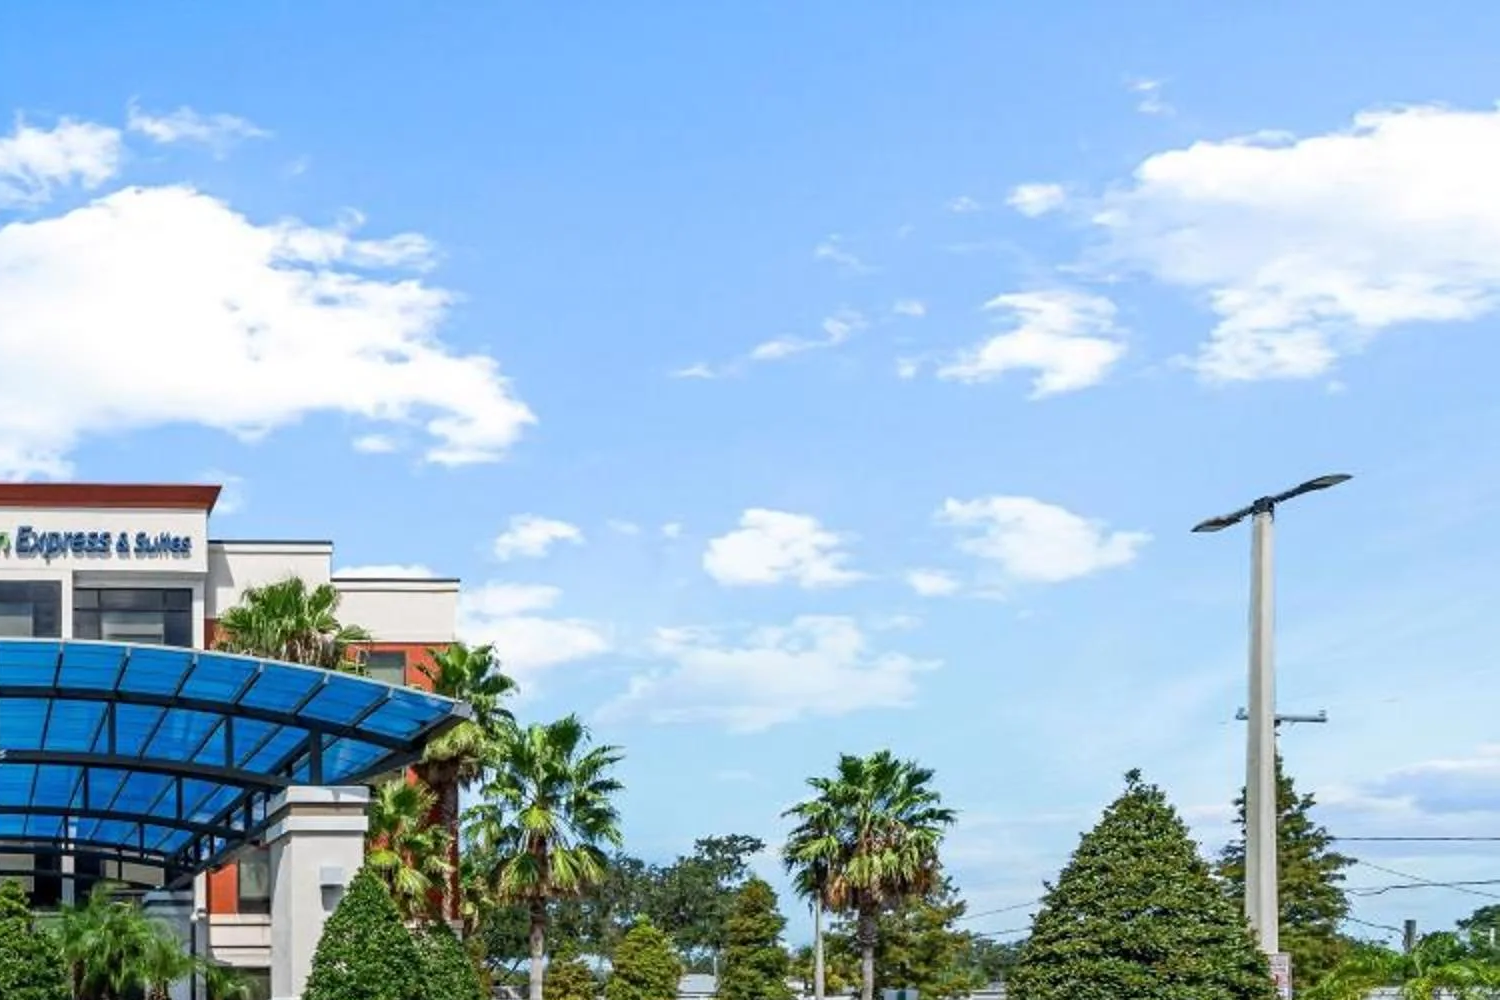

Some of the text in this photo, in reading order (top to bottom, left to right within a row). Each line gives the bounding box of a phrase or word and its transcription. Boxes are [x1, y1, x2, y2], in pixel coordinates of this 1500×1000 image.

[16, 526, 112, 561] Express
[116, 531, 130, 557] &
[134, 532, 192, 557] Suites
